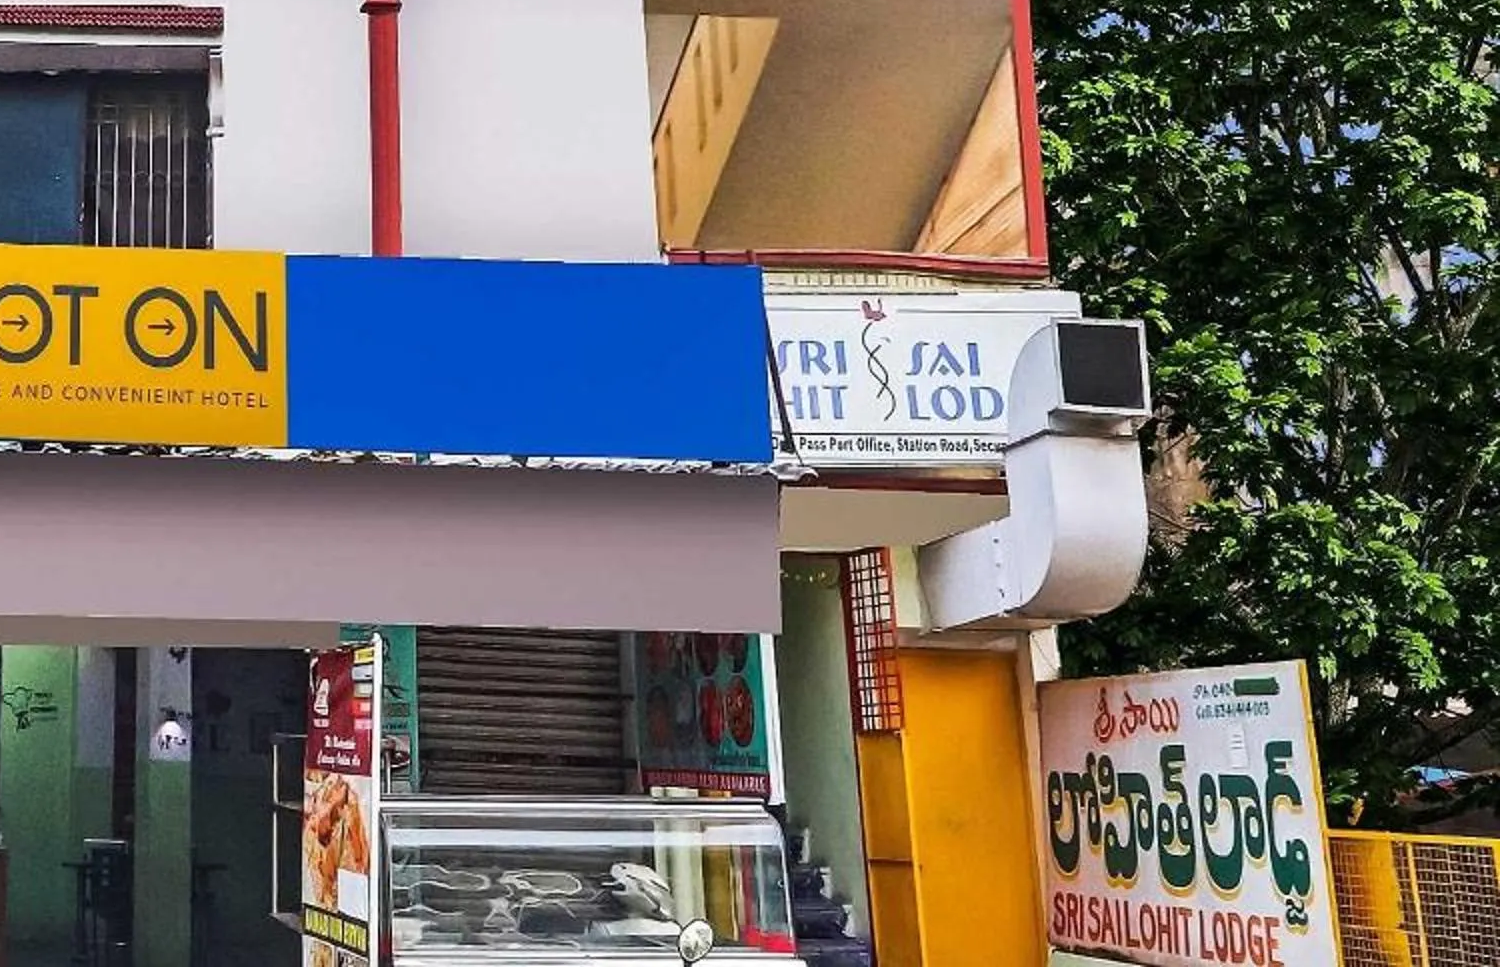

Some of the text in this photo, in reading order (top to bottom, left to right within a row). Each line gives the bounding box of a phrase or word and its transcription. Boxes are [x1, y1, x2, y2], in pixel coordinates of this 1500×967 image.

[124, 286, 269, 372] ON
[777, 339, 980, 378] SRI SAI
[12, 383, 53, 401] AND
[201, 390, 269, 409] HOTEL
[905, 383, 1005, 422] LOD
[799, 437, 826, 451] Pass
[856, 437, 895, 455] Office,
[898, 437, 937, 452] Station
[1052, 891, 1284, 967] SRI SAI LOHIT LODGE
